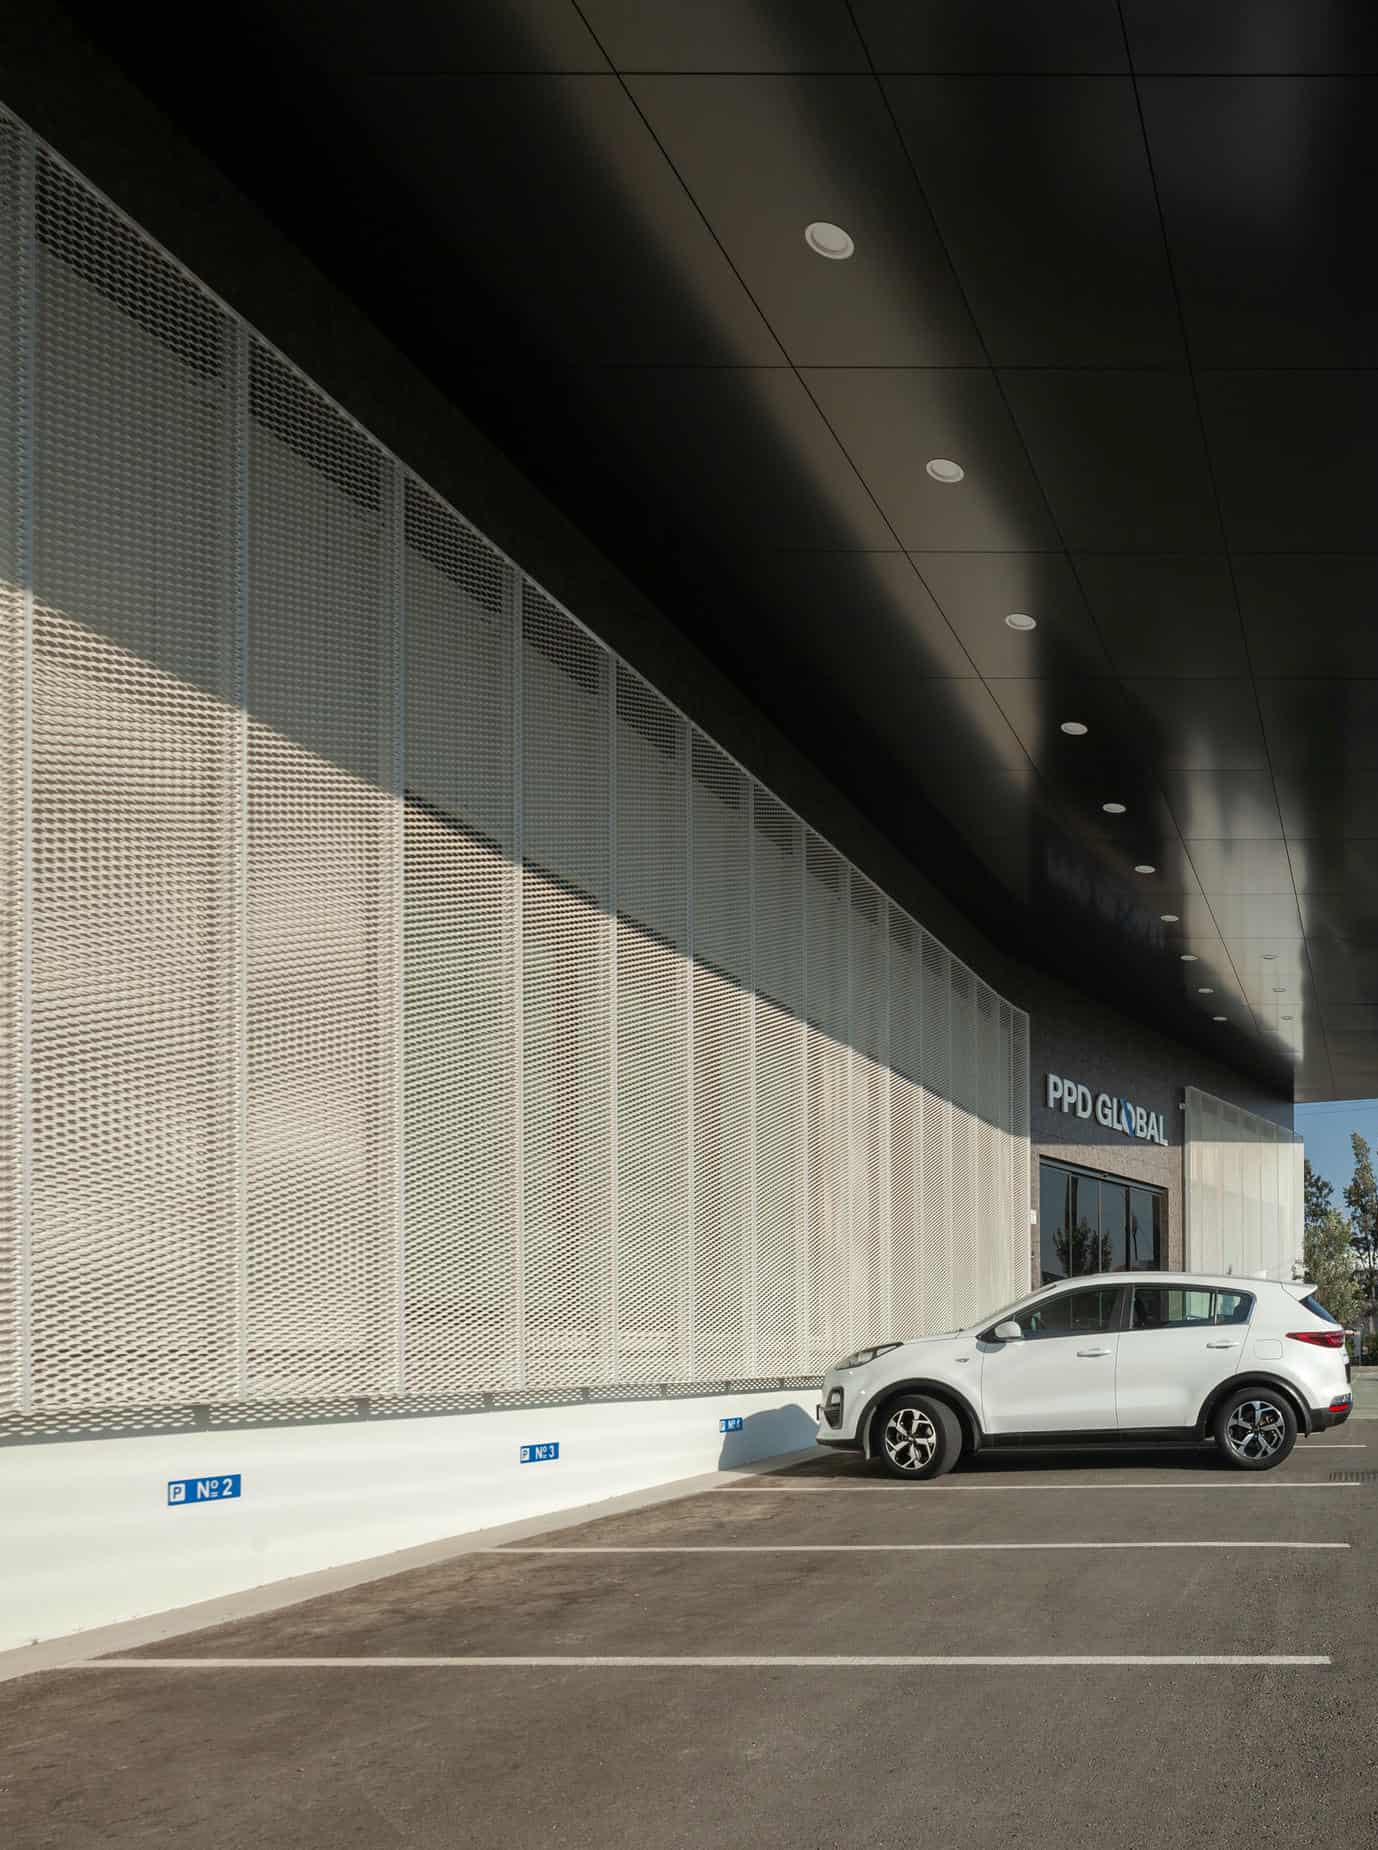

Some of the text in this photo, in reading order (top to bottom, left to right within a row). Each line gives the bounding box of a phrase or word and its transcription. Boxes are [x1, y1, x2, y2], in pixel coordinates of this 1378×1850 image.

[1047, 1073, 1169, 1147] PPD GLOBAL
[172, 1486, 183, 1500] P
[222, 1478, 233, 1497] 2
